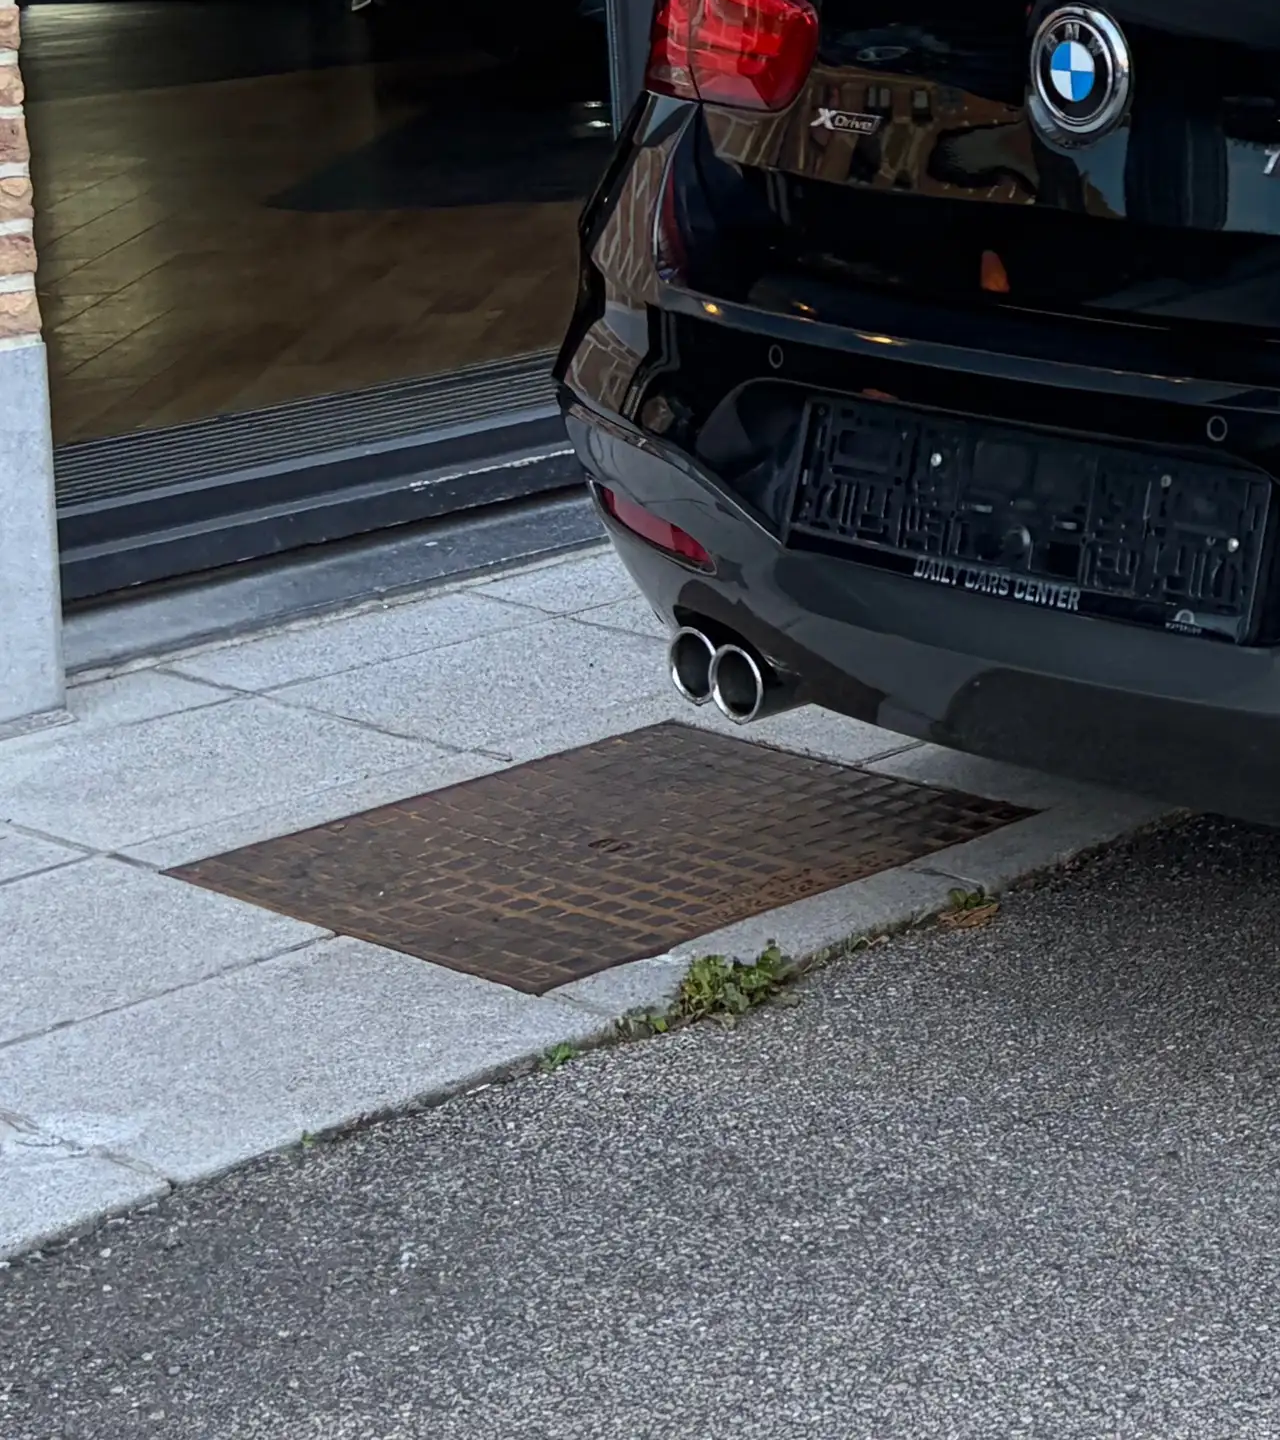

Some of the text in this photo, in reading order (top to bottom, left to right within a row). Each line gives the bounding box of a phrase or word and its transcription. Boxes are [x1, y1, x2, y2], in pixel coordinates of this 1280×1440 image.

[913, 555, 1081, 611] DAILY CARS CENTER
